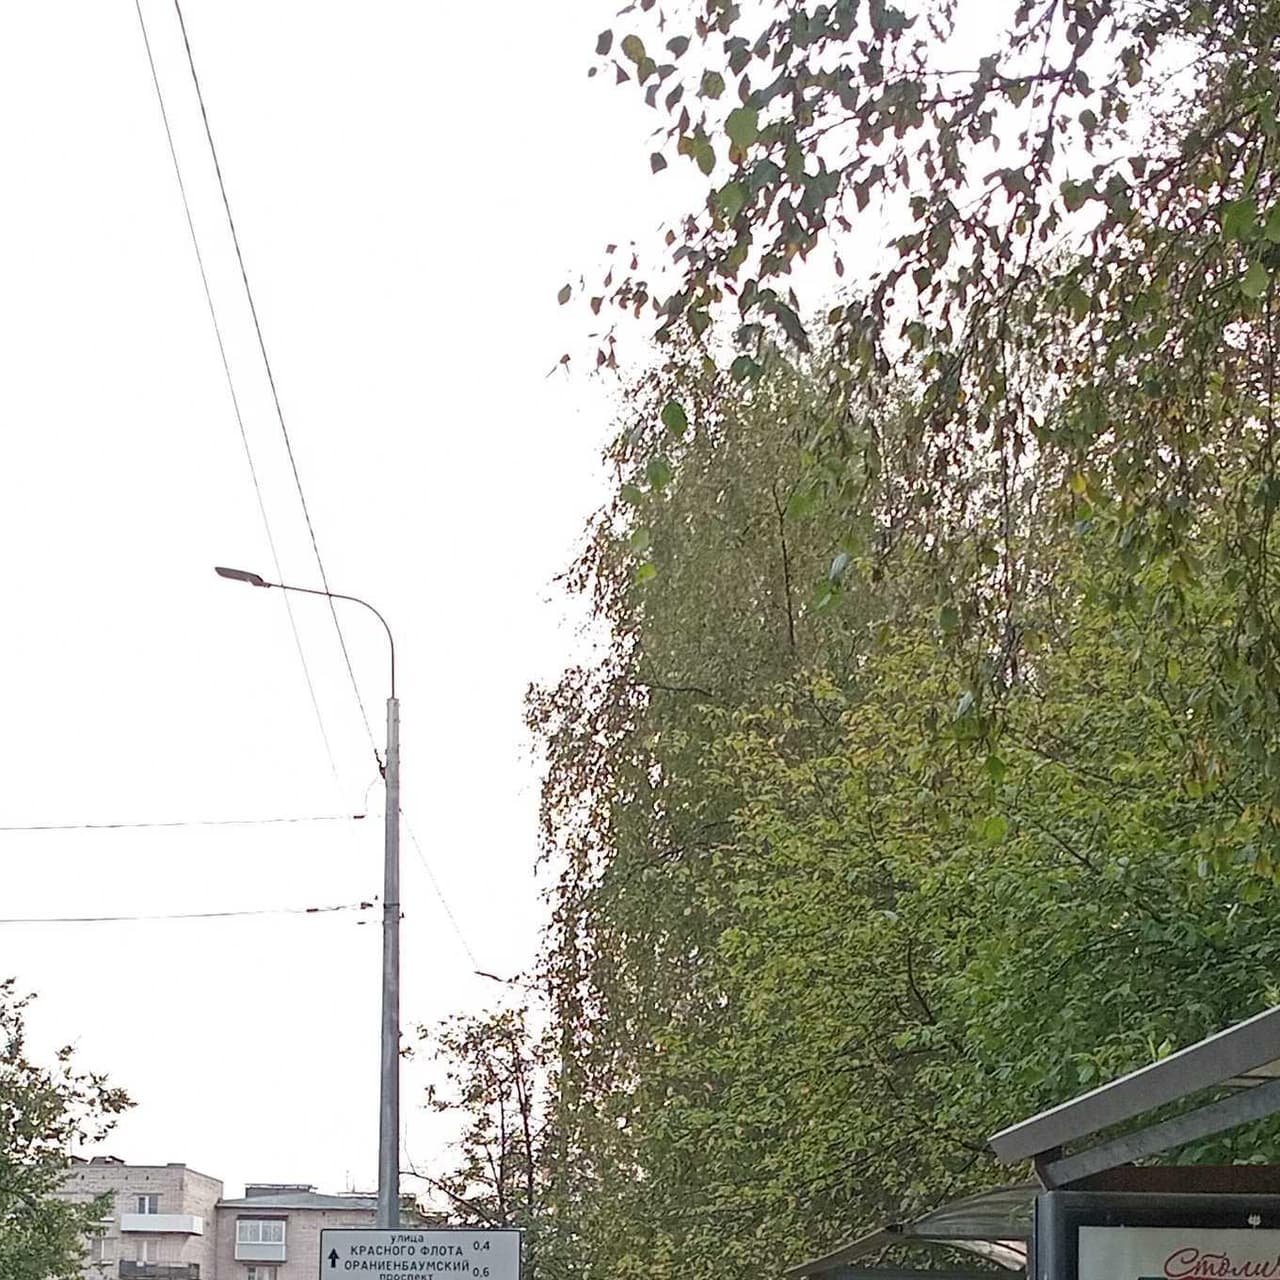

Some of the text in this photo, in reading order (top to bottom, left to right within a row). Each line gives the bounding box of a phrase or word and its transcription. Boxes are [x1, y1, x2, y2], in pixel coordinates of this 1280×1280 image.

[391, 1234, 424, 1244] улица
[350, 1245, 415, 1256] КРАСНОГО
[420, 1245, 463, 1256] ФЛОТА
[344, 1259, 469, 1271] ОРАНИЕНБАУМСКИЙ
